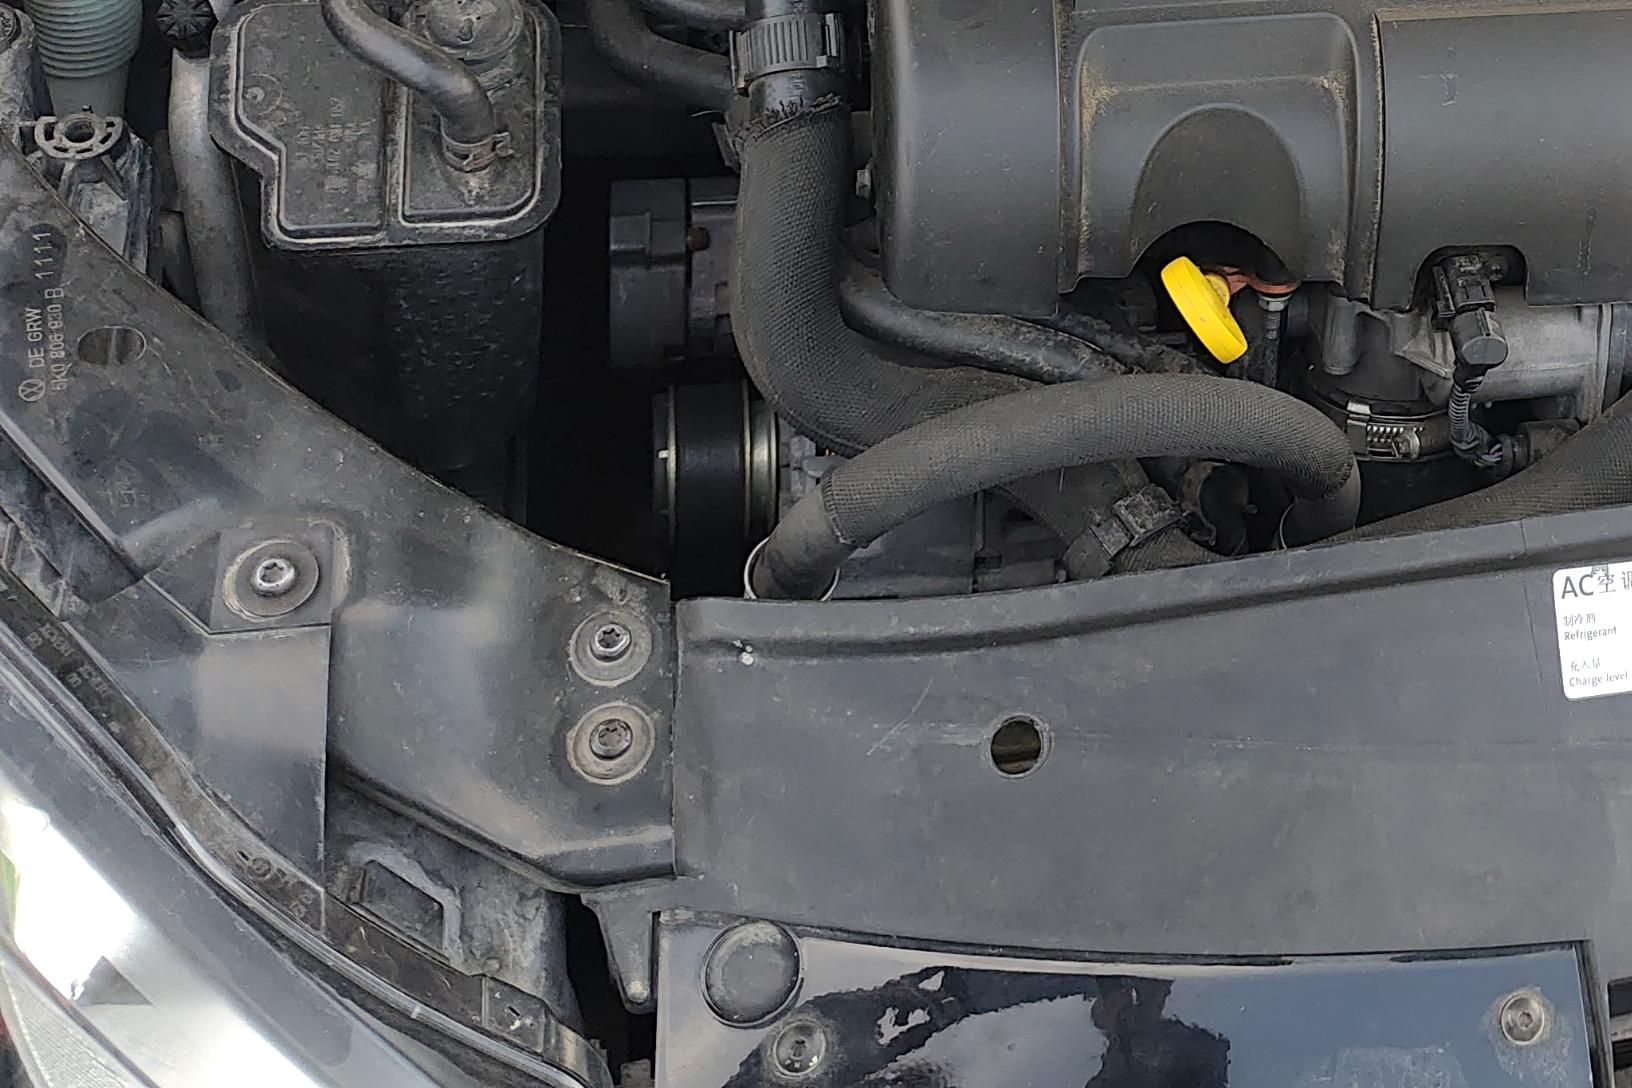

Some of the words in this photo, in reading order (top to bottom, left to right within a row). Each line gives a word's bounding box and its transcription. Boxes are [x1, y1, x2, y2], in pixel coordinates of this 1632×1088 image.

[25, 307, 44, 343] GRW
[1561, 574, 1595, 600] AC
[1564, 625, 1618, 641] Refrigerant
[1569, 675, 1603, 688] Charge
[1606, 671, 1628, 683] level
